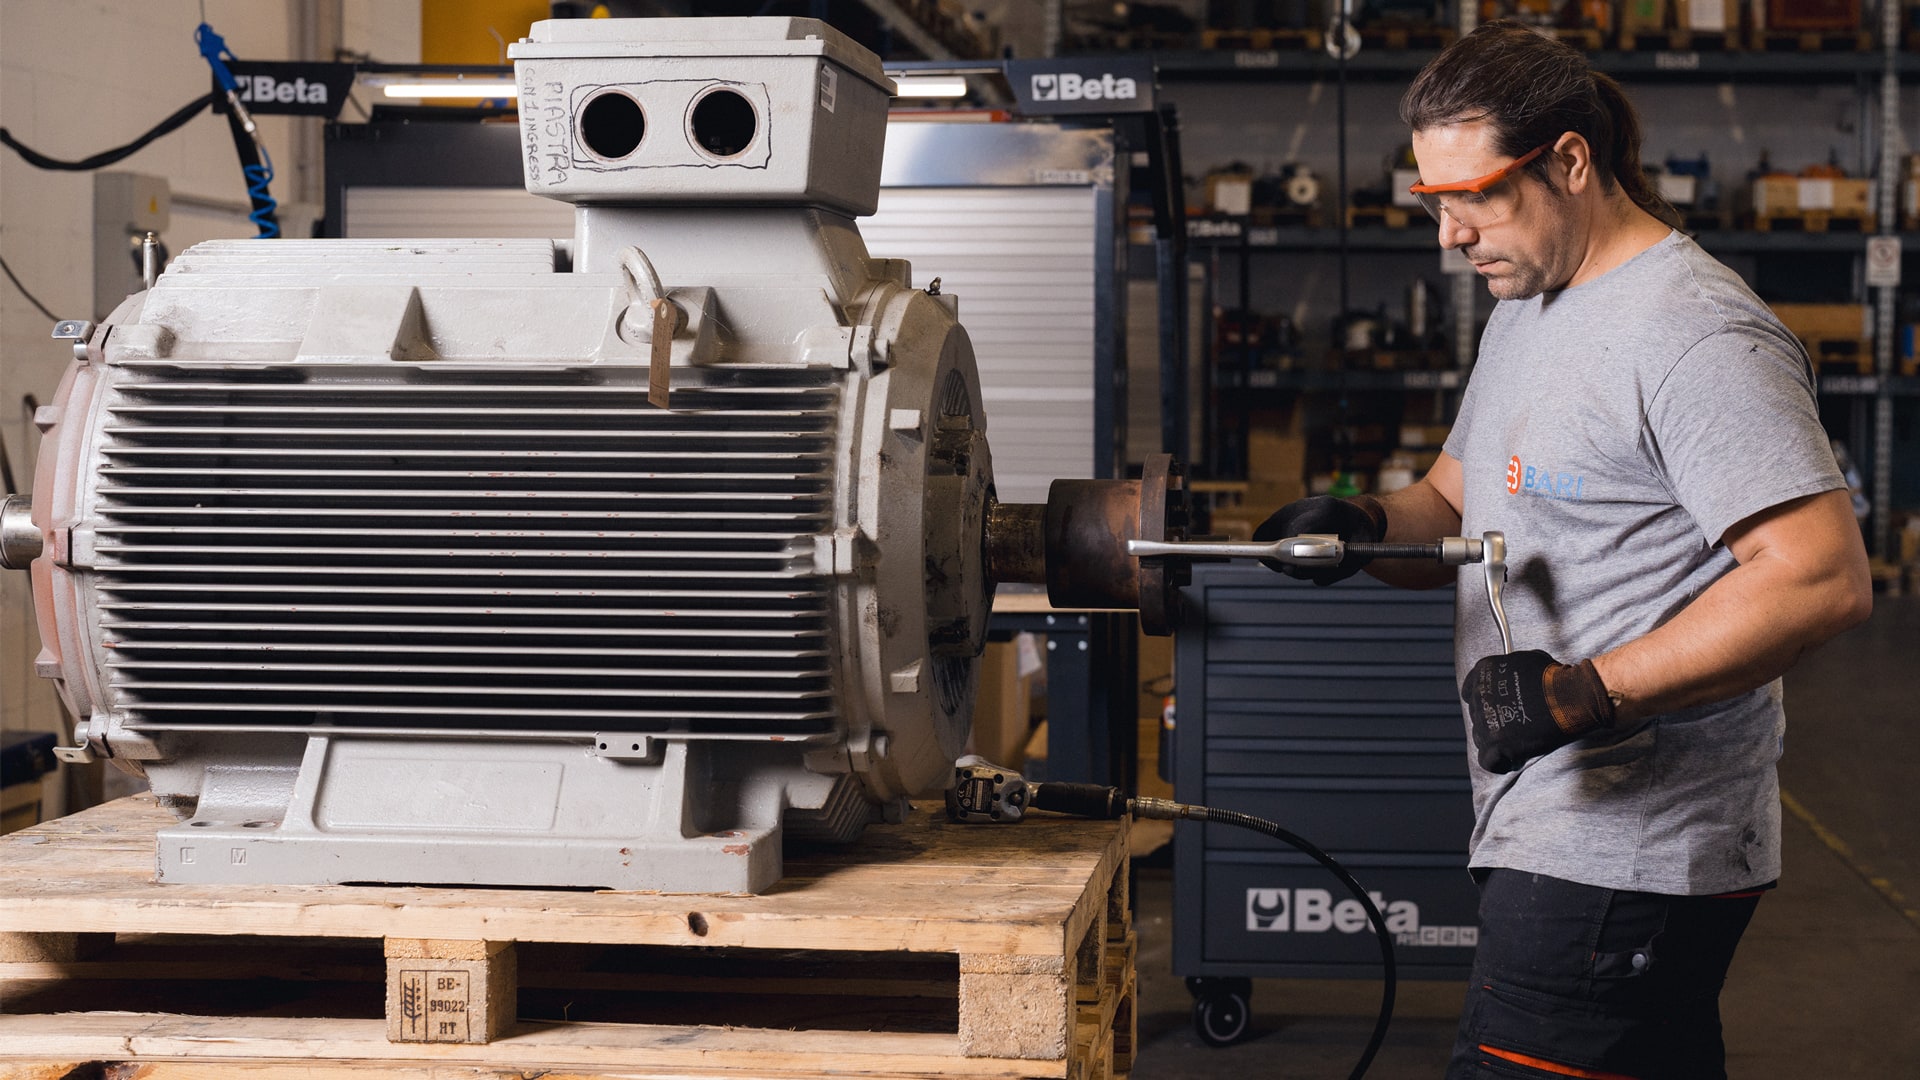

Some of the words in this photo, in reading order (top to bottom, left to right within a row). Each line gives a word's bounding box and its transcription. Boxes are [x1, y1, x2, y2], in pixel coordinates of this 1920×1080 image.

[253, 76, 327, 103] Beta
[1059, 74, 1136, 100] Beta
[544, 82, 570, 185] PIASTRA
[1524, 465, 1583, 499] BARI
[1294, 888, 1419, 933] Beta
[430, 999, 465, 1013] 99022
[439, 1021, 457, 1035] HT
